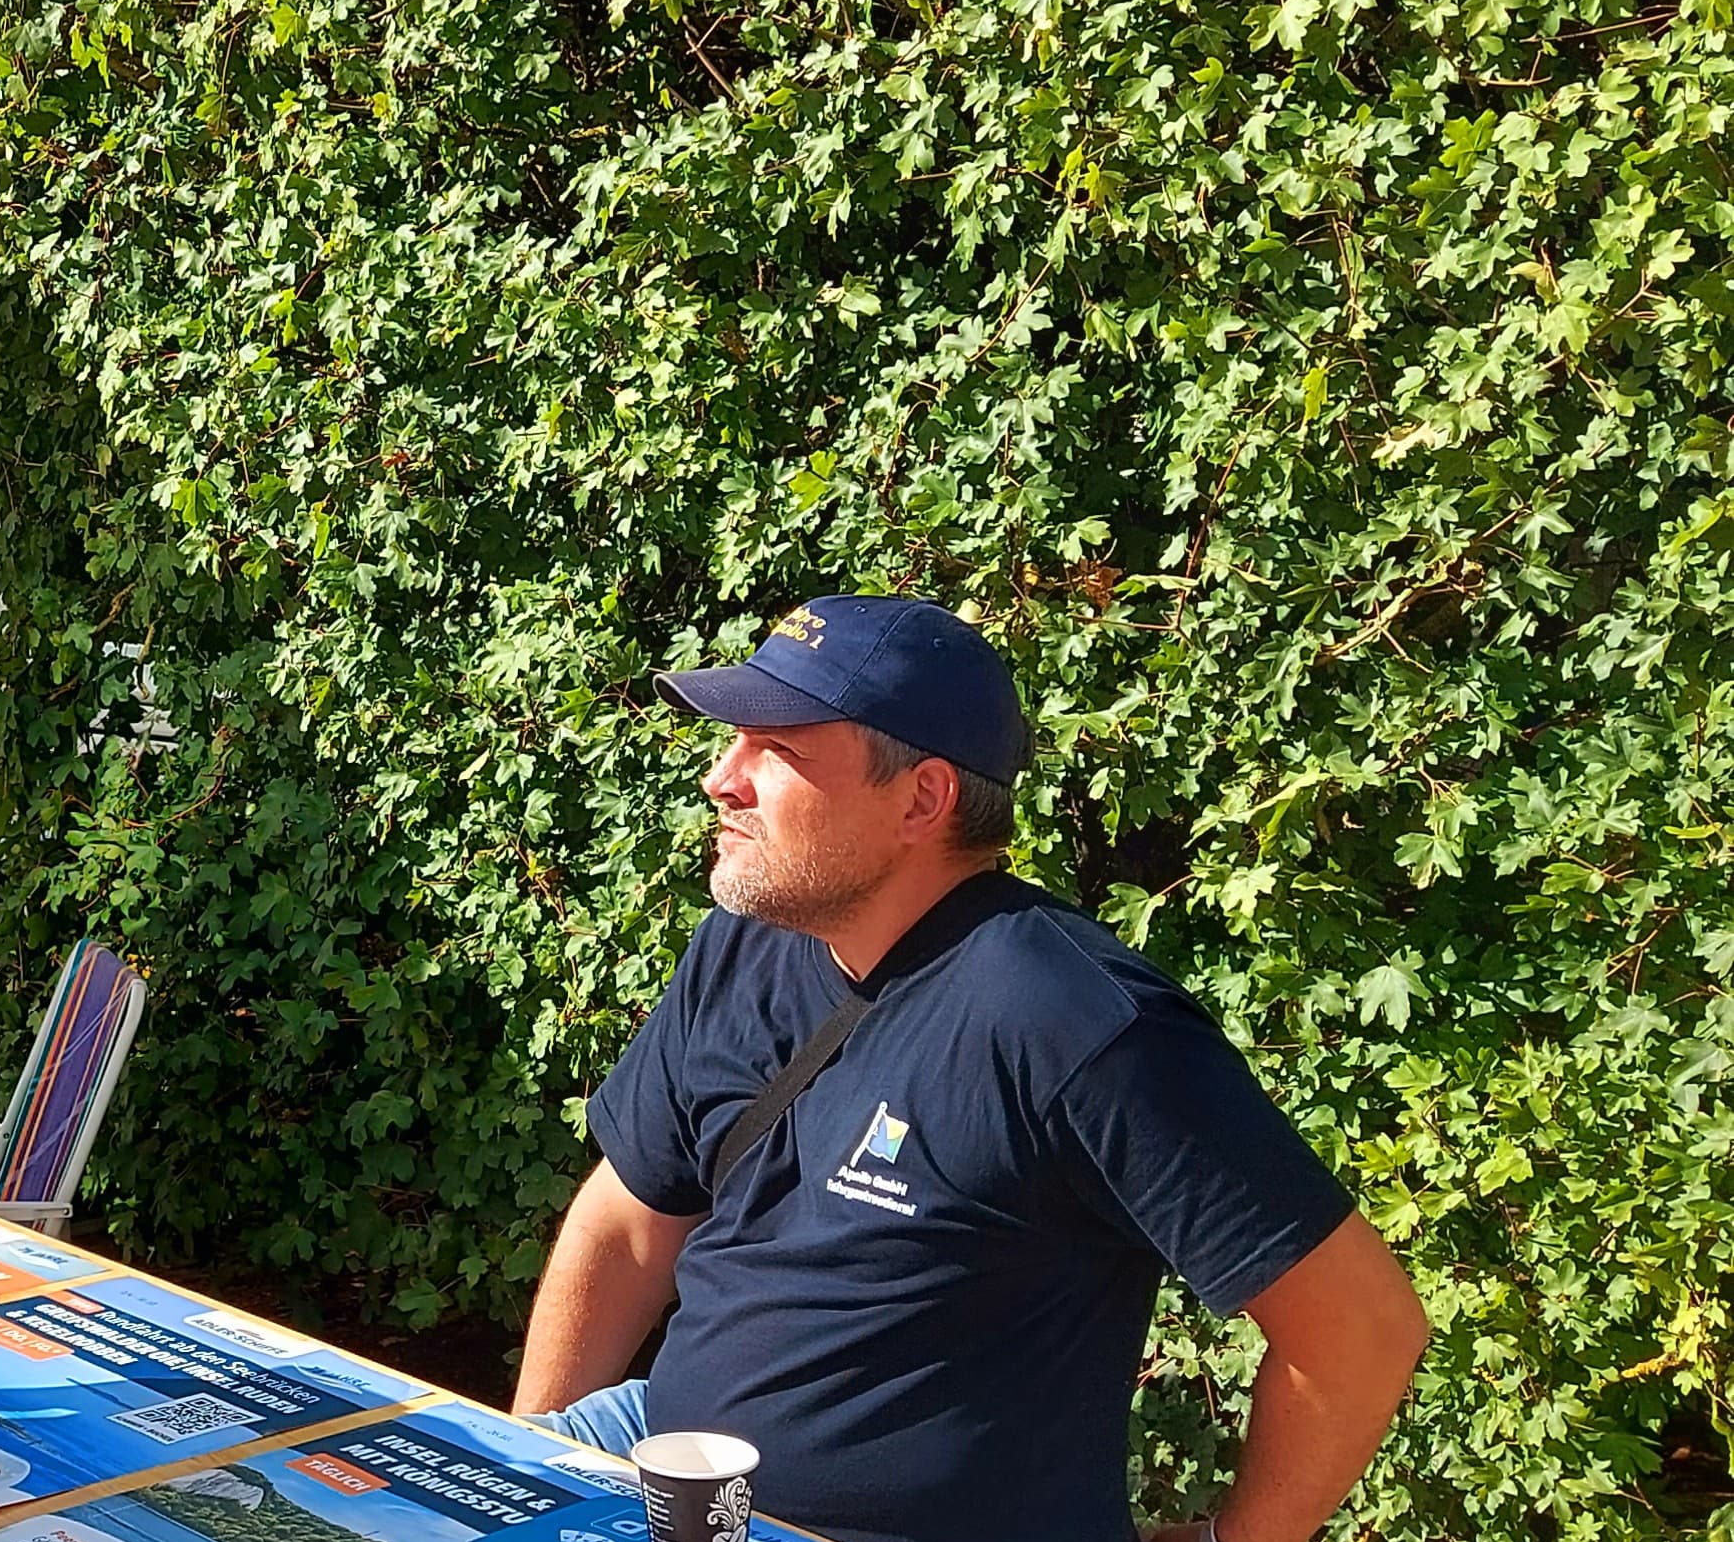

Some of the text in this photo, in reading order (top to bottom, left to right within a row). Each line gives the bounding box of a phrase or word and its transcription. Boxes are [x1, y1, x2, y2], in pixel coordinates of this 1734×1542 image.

[18, 1315, 139, 1365] KEGELROBBEN
[33, 1303, 156, 1355] GREIFSWALDER
[184, 1362, 240, 1390] INSEL
[232, 1384, 306, 1415] RUDEN
[94, 1311, 321, 1405] Rundfahrt ab den Seebrücken
[192, 1319, 290, 1356] ADLER-SCHIFFE
[303, 1457, 372, 1493] TÄGLICH
[338, 1442, 535, 1526] MIT KÖNIGSSTU
[373, 1433, 558, 1513] INSEL RÜGEN &
